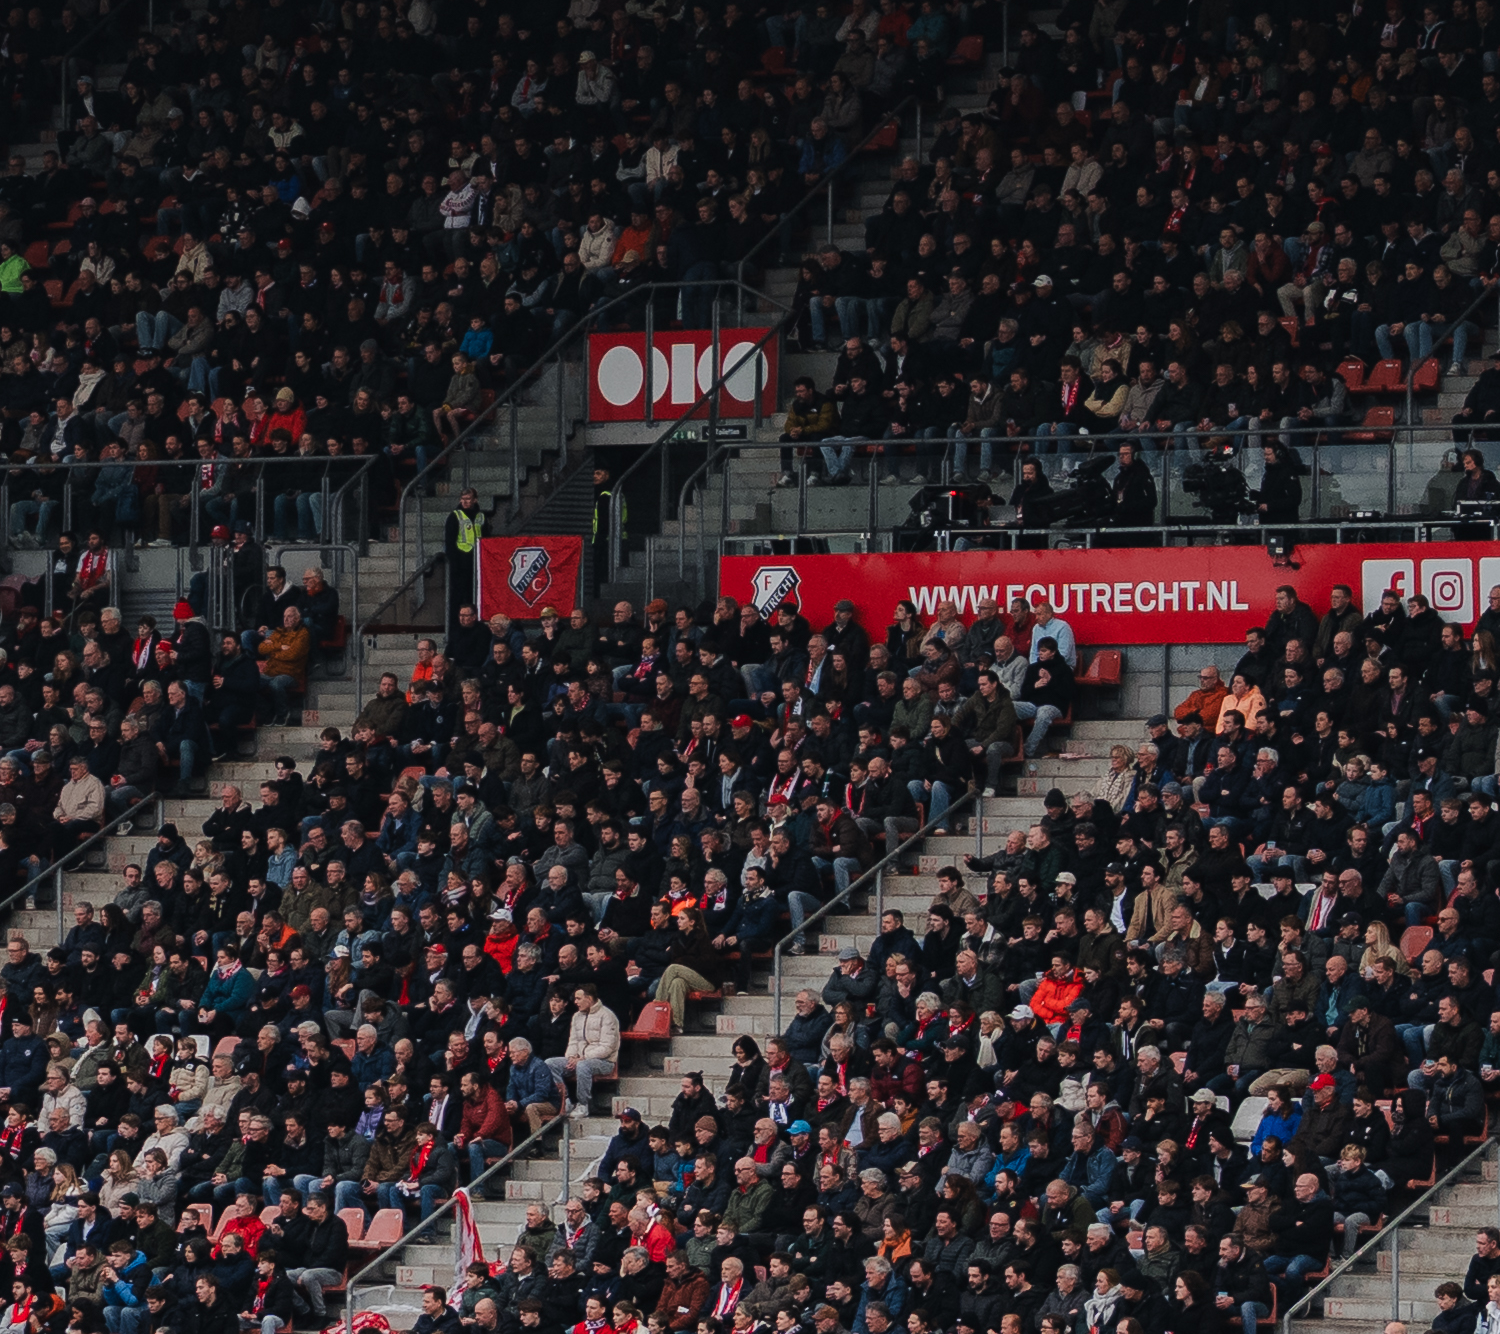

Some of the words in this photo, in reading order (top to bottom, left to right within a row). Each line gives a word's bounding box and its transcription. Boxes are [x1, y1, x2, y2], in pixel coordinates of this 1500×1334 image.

[514, 553, 547, 594] UTRECHT
[760, 571, 797, 621] UTRECHT
[908, 579, 1249, 620] WWW.FCUTRECHT.NL
[821, 937, 837, 951] 20
[1328, 1301, 1343, 1316] 12
